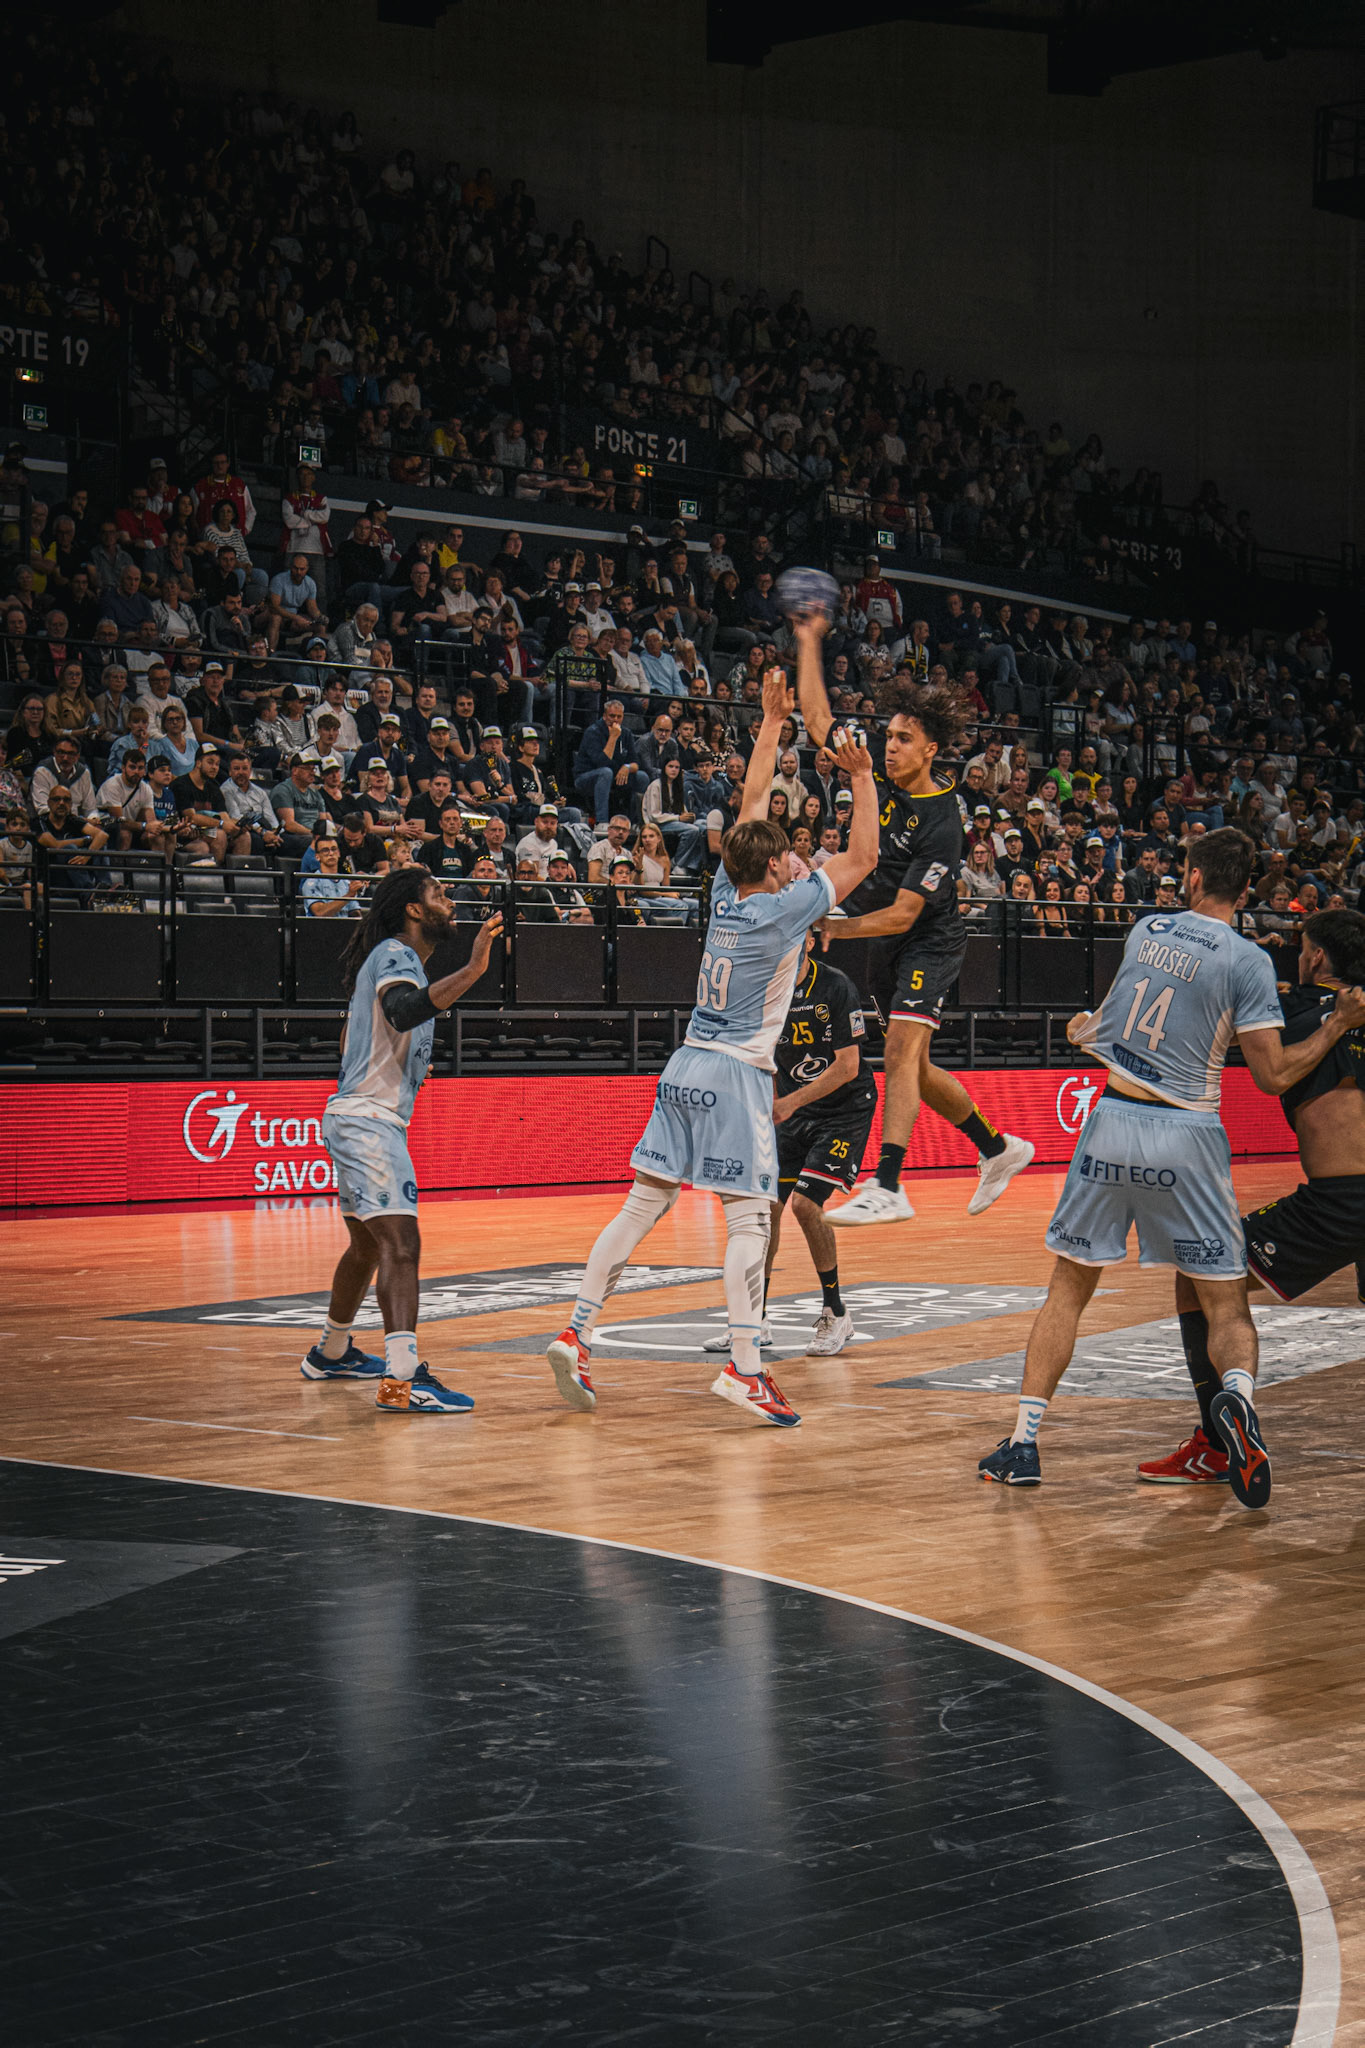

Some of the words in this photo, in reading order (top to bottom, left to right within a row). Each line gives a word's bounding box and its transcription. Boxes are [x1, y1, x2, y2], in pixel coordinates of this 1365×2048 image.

[61, 335, 89, 367] 19
[594, 423, 659, 459] PORTE
[666, 436, 688, 464] 21
[1136, 939, 1203, 984] GROŠELJ
[696, 951, 734, 1012] 69
[909, 970, 925, 991] 5
[1120, 976, 1177, 1053] 14
[791, 1021, 815, 1045] 25
[829, 1139, 852, 1160] 25
